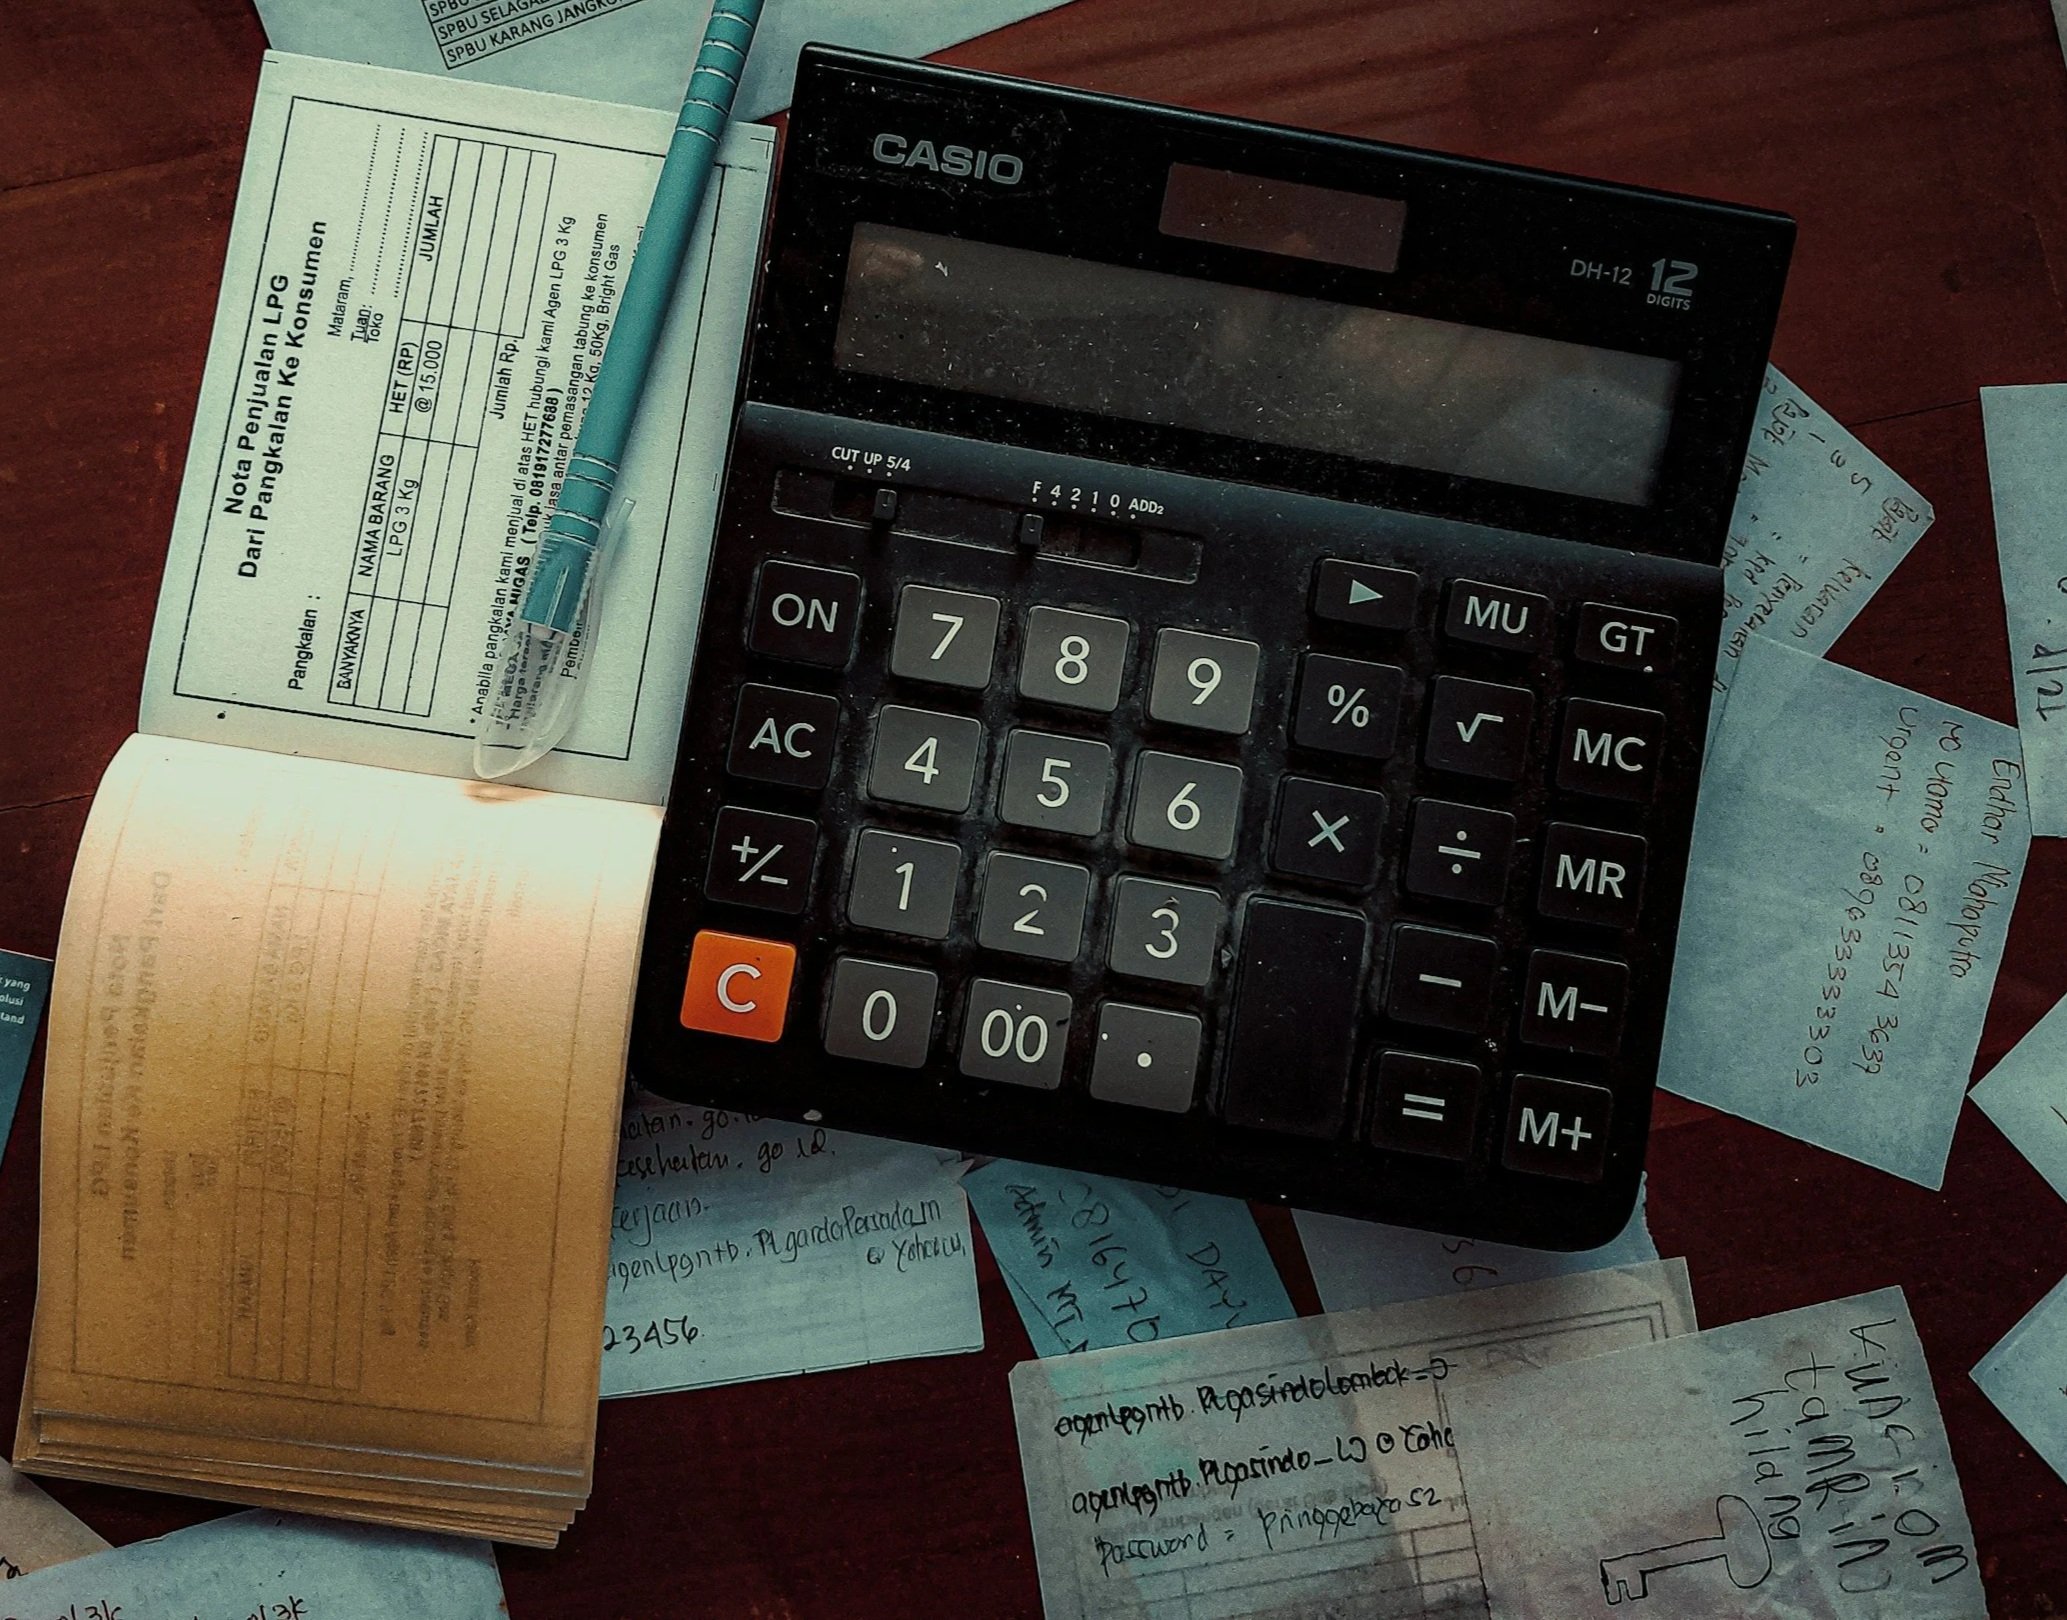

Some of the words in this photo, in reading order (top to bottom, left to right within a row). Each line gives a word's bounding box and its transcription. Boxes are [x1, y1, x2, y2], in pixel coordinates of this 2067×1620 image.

[438, 15, 478, 40] SPBU
[446, 37, 487, 63] SPBU
[489, 14, 555, 47] KARANG
[873, 133, 1023, 185] CASIO
[419, 195, 444, 262] JUMLAH
[556, 237, 569, 246] 3
[558, 216, 576, 234] Kg
[549, 250, 567, 280] LPG
[584, 213, 608, 282] konsumen
[604, 244, 621, 272] Gas
[284, 220, 327, 348] Konsumen
[581, 285, 596, 301] ke
[1570, 258, 1632, 285] DH-12
[1651, 258, 1699, 297] 12
[262, 274, 289, 325] LPG
[543, 284, 562, 319] Agen
[597, 274, 616, 315] Bright
[1646, 293, 1691, 311] DIGITS
[365, 312, 384, 343] Toko
[536, 320, 556, 352] kami
[573, 303, 595, 351] tabung
[588, 319, 610, 357] 50Kg,
[277, 356, 300, 387] Ke
[419, 340, 443, 391] 15.000
[499, 338, 520, 363] Rp.
[237, 333, 278, 451] Penjualan
[388, 383, 409, 414] HET
[401, 341, 420, 377] (RP)
[490, 370, 513, 420] Jumlah
[527, 355, 551, 410] hubungi
[560, 353, 584, 441] pemasangan
[414, 397, 432, 413] @
[520, 412, 537, 442] HET
[250, 395, 292, 521] Pangkalan
[518, 447, 533, 475] atas
[553, 442, 569, 479] antar
[831, 445, 860, 463] CUT
[863, 451, 883, 466] UP
[886, 455, 911, 472] 5/4
[223, 459, 252, 514] Nota
[369, 454, 395, 526] BARANG
[398, 479, 419, 500] Kg
[513, 478, 526, 491] di
[1032, 480, 1042, 495] F
[1050, 483, 1061, 498] 4
[1070, 487, 1081, 501] 2
[1091, 490, 1099, 505] 1
[1110, 494, 1120, 508] 0
[395, 505, 411, 515] 3
[505, 494, 524, 548] menjual
[522, 501, 543, 534] Telp.
[237, 528, 266, 578] Dari
[387, 519, 408, 556] LPG
[494, 551, 514, 584] kami
[485, 588, 507, 660] pangkalan
[771, 592, 838, 633] ON
[1464, 595, 1529, 634] MU
[287, 608, 318, 690] Pangkalan
[336, 609, 366, 690] BANYAKNYA
[931, 612, 964, 660] 7
[1600, 621, 1655, 656] GT
[1054, 635, 1091, 685] 8
[1187, 657, 1222, 706] 9
[1327, 684, 1370, 728] %
[748, 716, 817, 759] AC
[1572, 728, 1646, 772] MC
[904, 736, 939, 784] 4
[1036, 758, 1072, 808] 5
[1166, 782, 1201, 831] 6
[894, 862, 914, 911] 1
[1555, 854, 1626, 899] MR
[1013, 883, 1048, 936] 2
[1145, 907, 1179, 959] 3
[716, 962, 762, 1013] C
[1537, 981, 1608, 1021] M-
[862, 988, 898, 1041] 0
[980, 1007, 1049, 1063] 00
[1518, 1107, 1592, 1151] M+
